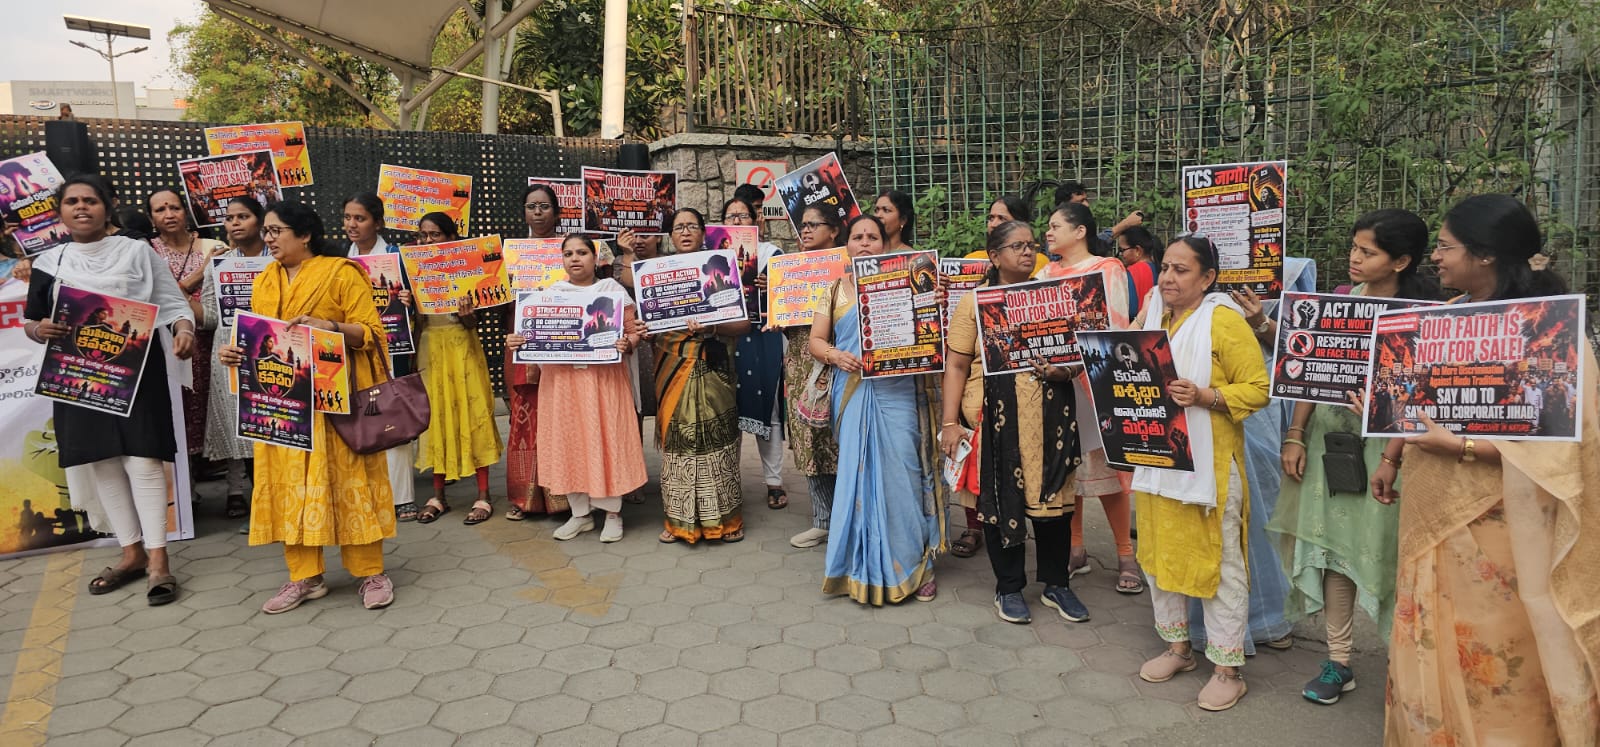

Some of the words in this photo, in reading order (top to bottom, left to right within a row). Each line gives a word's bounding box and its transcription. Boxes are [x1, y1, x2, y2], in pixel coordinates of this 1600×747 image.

[200, 163, 214, 176] OUR
[216, 160, 236, 174] FAITH
[238, 158, 247, 171] IS
[202, 176, 216, 188] NOT
[216, 174, 230, 186] FOR
[606, 175, 621, 186] OUR
[623, 176, 642, 187] FAITH
[644, 177, 652, 188] IS
[1186, 169, 1211, 189] TCS
[1214, 166, 1248, 186] जागो!
[566, 184, 582, 195] FAIT
[605, 188, 619, 197] NOT
[620, 189, 634, 198] FOR
[635, 189, 655, 199] SALE!
[564, 196, 576, 206] FOR
[636, 211, 643, 219] TO
[764, 206, 784, 216] OKING
[856, 258, 878, 276] TCS
[879, 255, 907, 273] जागो!
[942, 262, 960, 275] TCS
[652, 271, 674, 281] STRICT
[674, 268, 697, 278] ACTION
[663, 281, 698, 291] COMPROMISE
[1006, 291, 1028, 308] OUR
[1029, 286, 1059, 305] FAITH
[1059, 285, 1071, 301] IS
[1007, 307, 1027, 323] NOT
[1029, 305, 1047, 321] FOR
[1048, 300, 1076, 318] SALE!
[1322, 301, 1352, 319] ACT
[1354, 302, 1388, 319] NOW
[1320, 318, 1331, 328] OR
[1332, 319, 1346, 329] WE
[1347, 318, 1373, 330] WON'T
[1420, 317, 1452, 340] OUR
[1454, 313, 1501, 339] FAITH
[1502, 312, 1520, 335] IS
[80, 326, 124, 344] మహిళా
[1027, 336, 1042, 348] SAY
[1043, 335, 1054, 345] NO
[1054, 334, 1064, 345] TO
[77, 336, 120, 355] కవచం
[1316, 336, 1358, 350] RESPECT
[1416, 341, 1444, 363] NOT
[1447, 339, 1477, 362] FOR
[1478, 336, 1523, 361] SALE!
[1008, 351, 1021, 360] SAY
[1021, 349, 1031, 358] NO
[1039, 344, 1073, 356] CORPORATE
[1314, 349, 1326, 357] OR
[1327, 348, 1345, 359] FACE
[1346, 349, 1360, 359] THE
[258, 360, 293, 376] మహిళా
[1305, 361, 1338, 373] STRONG
[1431, 366, 1440, 375] No
[1441, 366, 1457, 375] More
[1458, 364, 1504, 375] Discrimination
[258, 372, 292, 388] కవచం
[1113, 368, 1152, 382] కంపెనీ
[1304, 371, 1330, 382] STRONG
[1331, 374, 1357, 385] ACTION
[1428, 376, 1452, 386] Against
[1452, 375, 1471, 385] Hindu
[1435, 388, 1458, 404] SAY
[1459, 388, 1478, 404] NO
[1479, 387, 1495, 403] TO
[1113, 406, 1167, 421] అన్యాయానికి
[1404, 405, 1422, 418] SAY
[1423, 405, 1438, 418] NO
[1437, 405, 1450, 418] TO
[1451, 404, 1505, 419] CORPORATE
[1505, 405, 1536, 420] JIHAD.
[1122, 419, 1165, 442] మద్దతు
